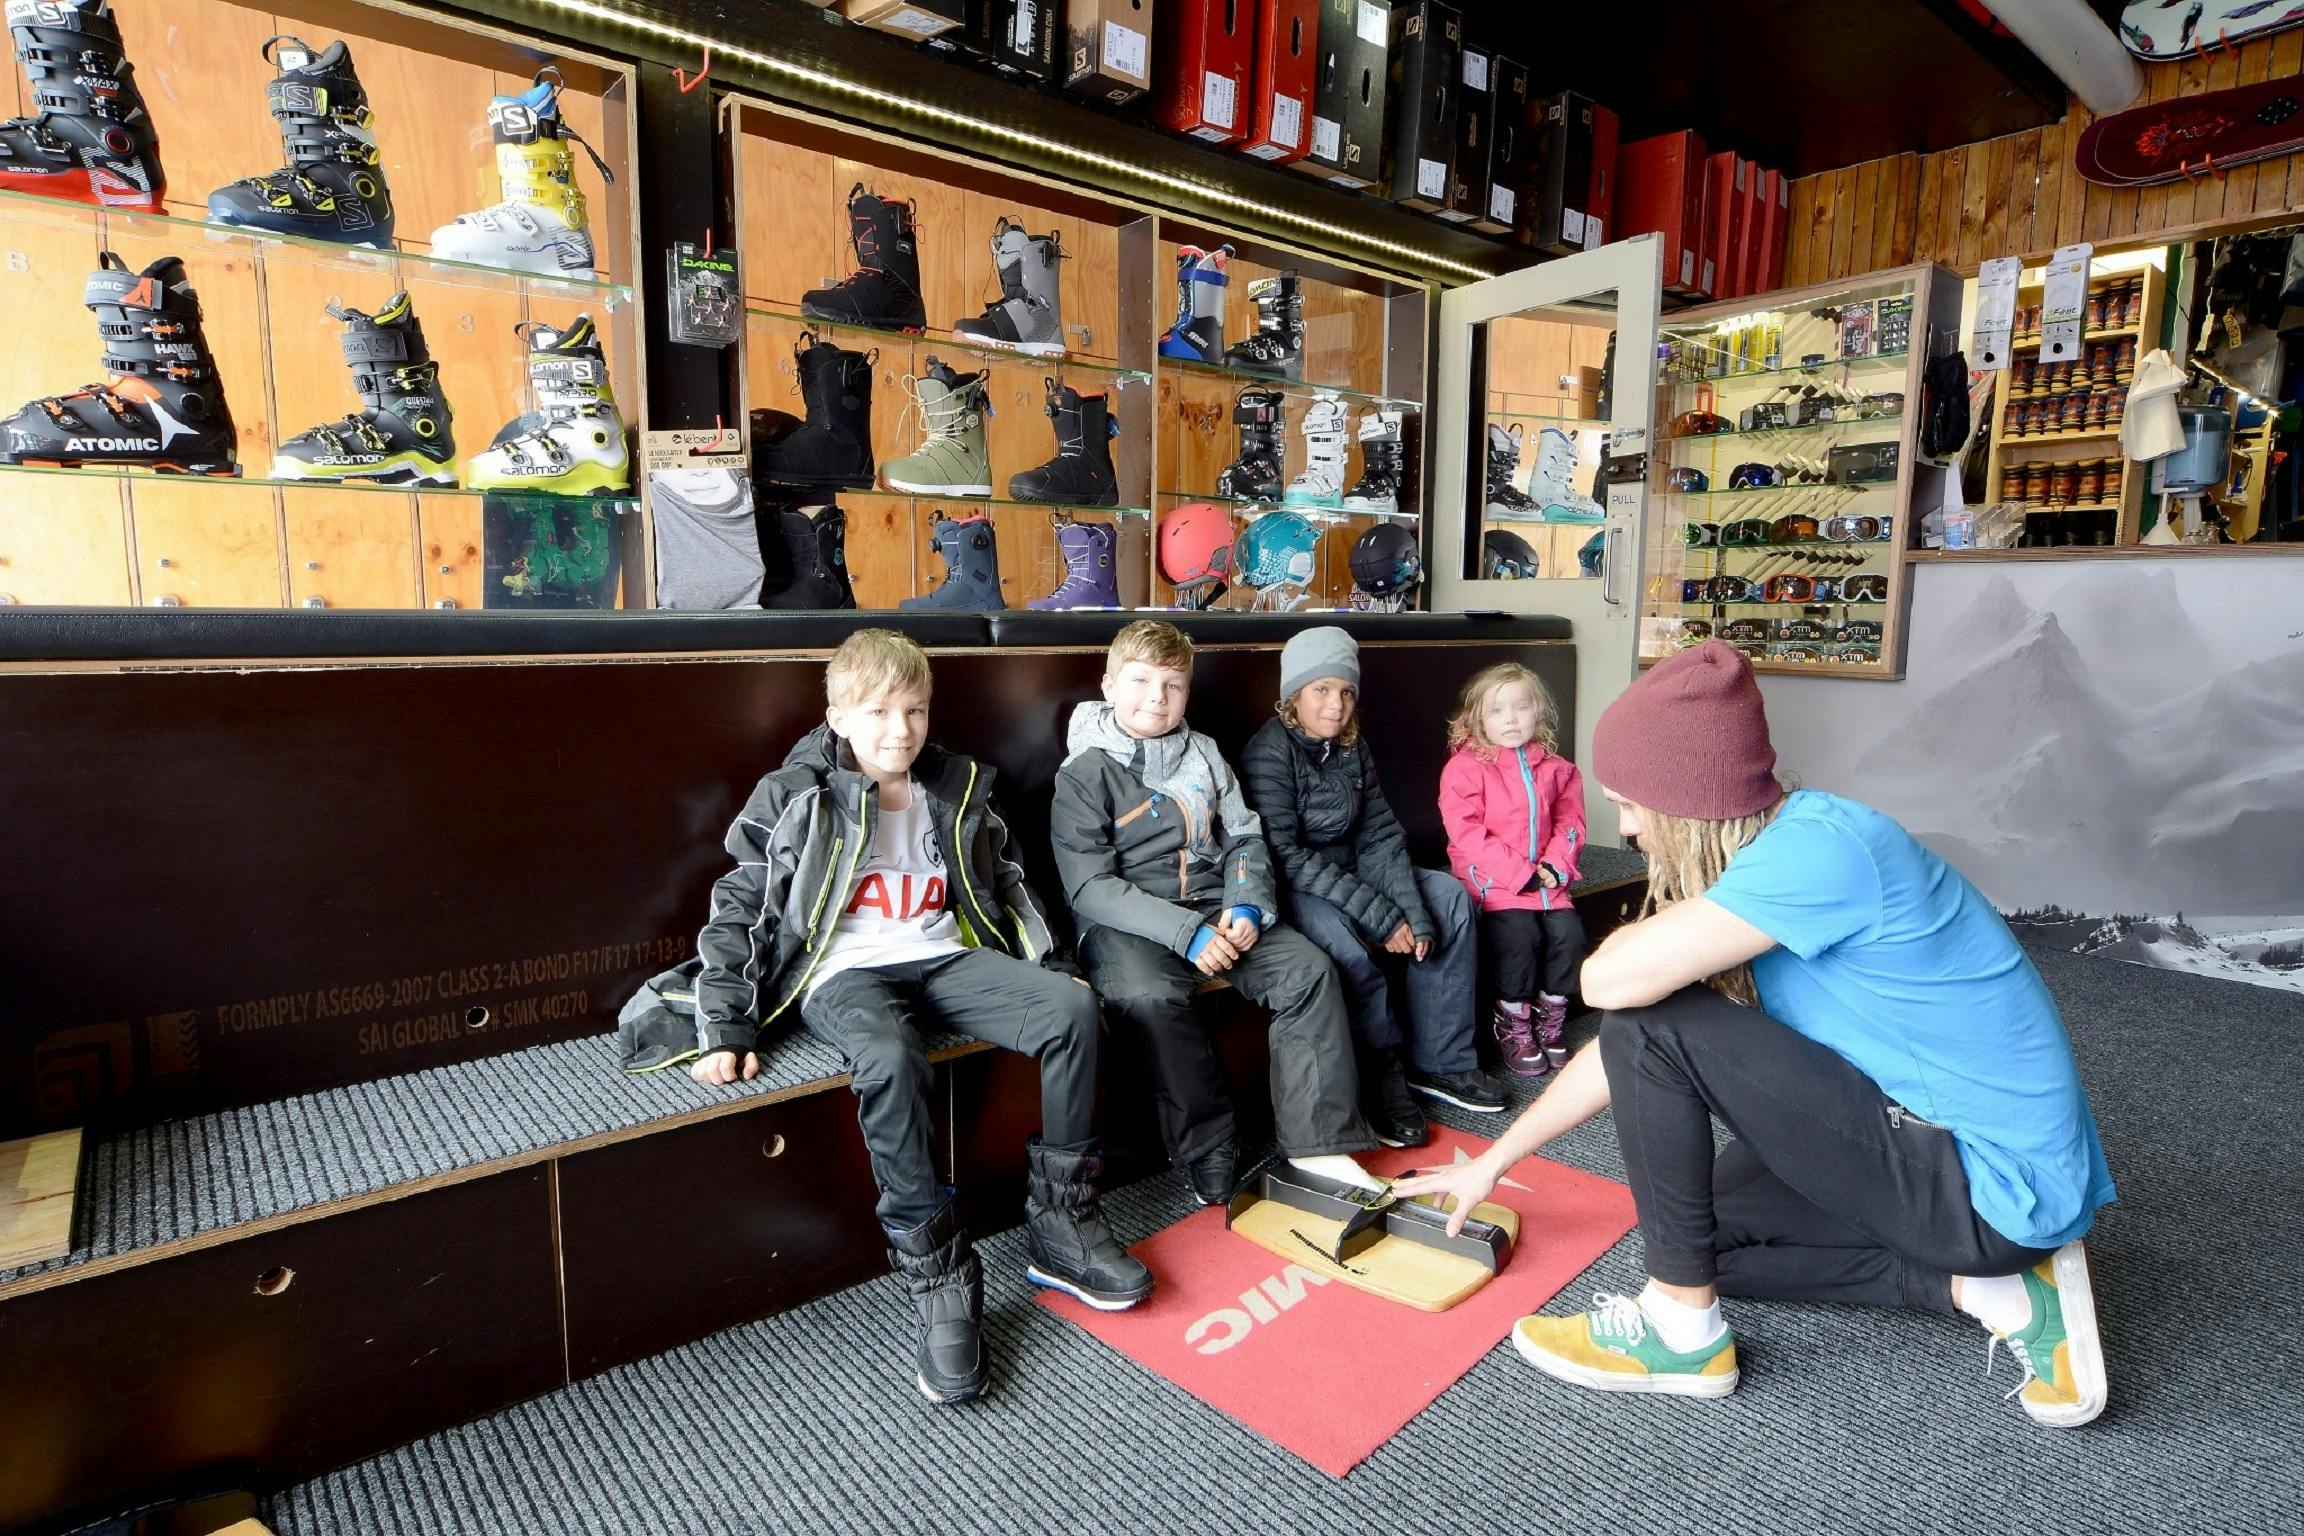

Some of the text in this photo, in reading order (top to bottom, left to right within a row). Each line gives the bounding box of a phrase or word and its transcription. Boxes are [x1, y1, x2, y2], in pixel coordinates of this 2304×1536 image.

[1068, 64, 1092, 82] salomon
[8, 165, 49, 174] salomon
[258, 204, 299, 215] salomon
[681, 257, 736, 273] DAKINE
[154, 343, 196, 355] HAWX
[63, 437, 160, 452] ATOMIC
[313, 454, 385, 466] salomon
[501, 464, 567, 476] salomon
[1611, 495, 1636, 505] PULL
[845, 872, 945, 920] AIA
[218, 991, 311, 1035] FORMPLY
[315, 974, 433, 1019] AS6669-2007
[437, 965, 489, 1000] CLASS
[523, 954, 571, 985] BOND
[573, 943, 630, 977] F17/F17
[358, 1022, 388, 1055] SAI
[391, 1011, 462, 1049] GLOBAL
[503, 1002, 540, 1030] SMK
[541, 989, 589, 1020] 40270
